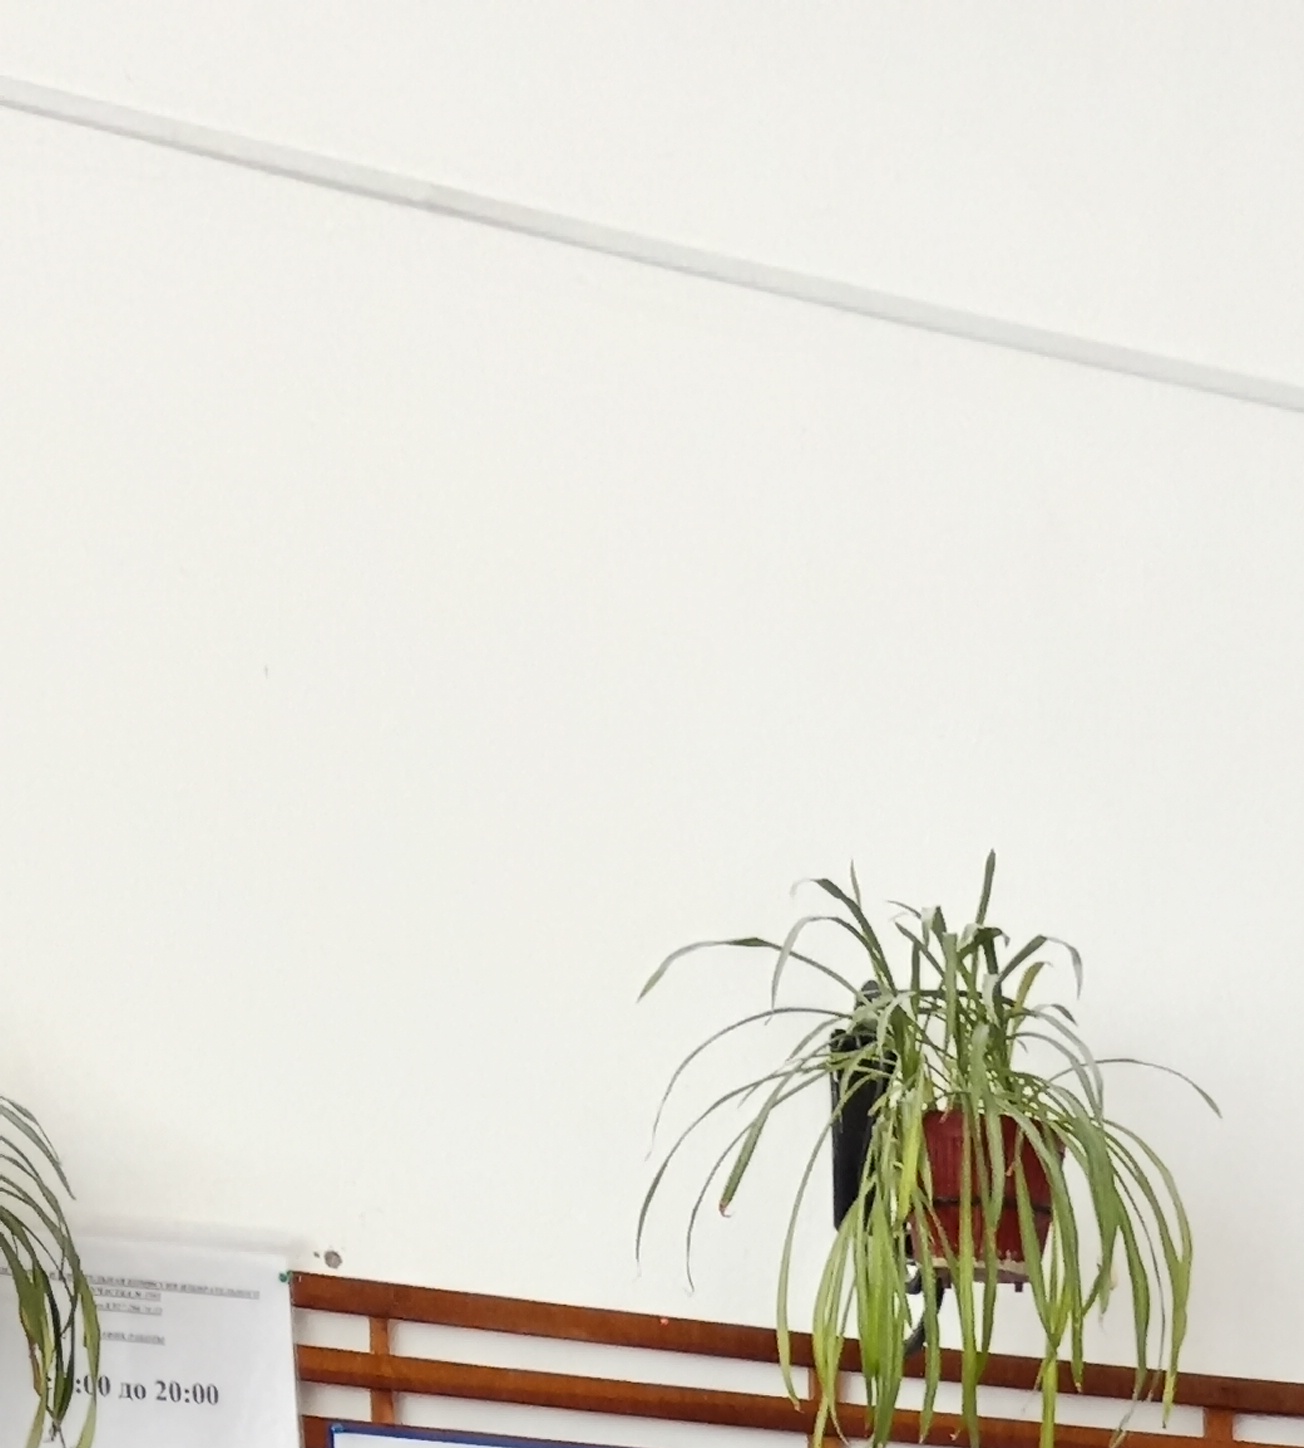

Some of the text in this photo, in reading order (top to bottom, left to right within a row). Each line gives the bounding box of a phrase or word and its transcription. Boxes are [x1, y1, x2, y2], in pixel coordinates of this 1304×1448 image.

[75, 1374, 219, 1405] :00 до 20:00
